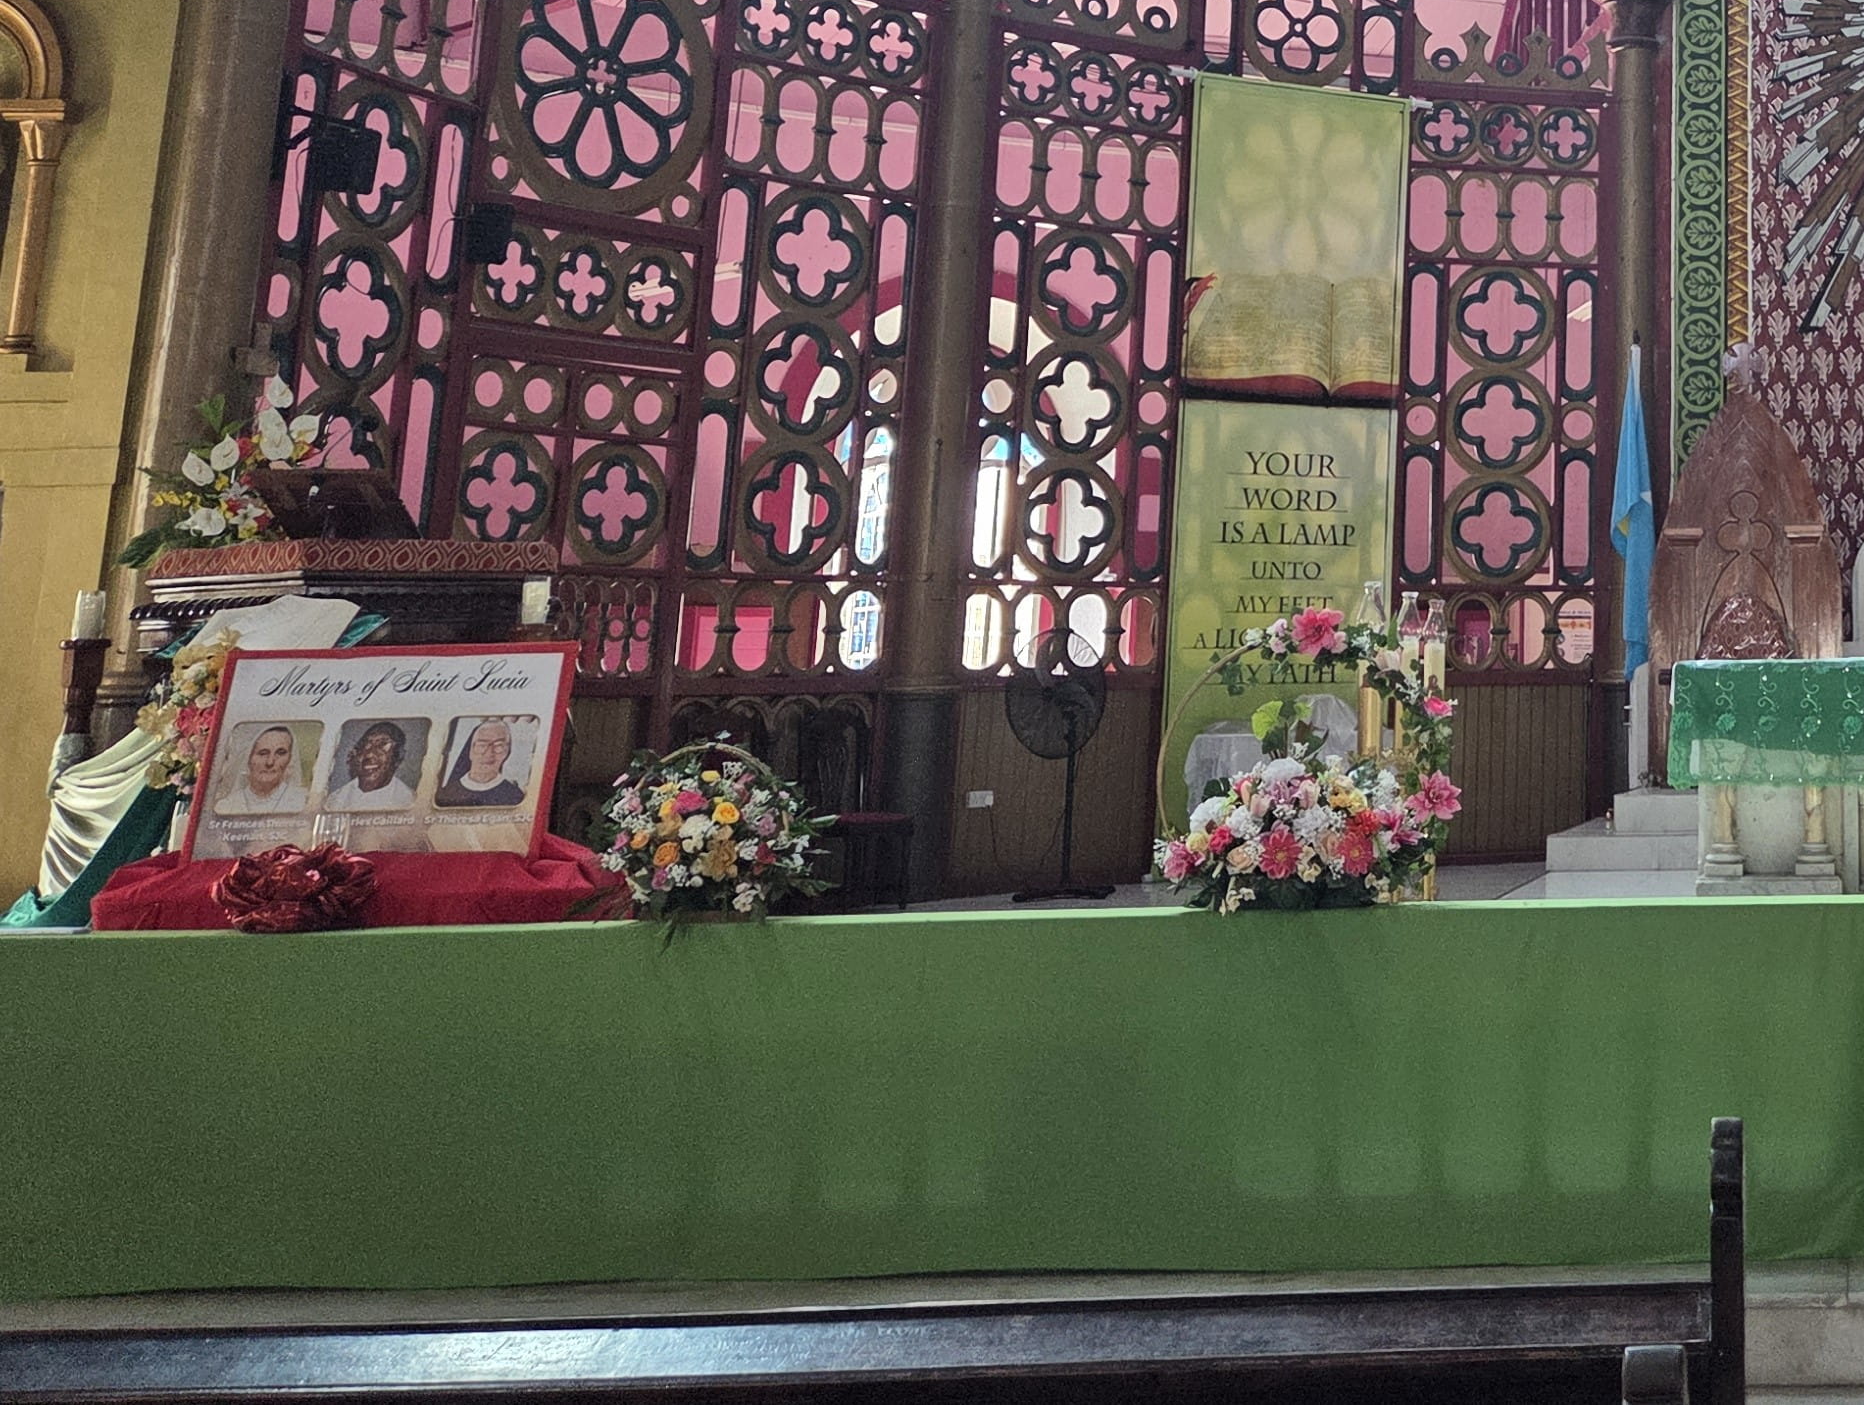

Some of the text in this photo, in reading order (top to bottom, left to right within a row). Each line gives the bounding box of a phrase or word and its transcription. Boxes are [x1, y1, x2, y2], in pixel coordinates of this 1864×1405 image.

[1246, 451, 1337, 478] YOUR
[1241, 487, 1337, 512] WORD
[1220, 521, 1355, 546] IS A LAMP
[1251, 561, 1322, 580] UNTO
[1235, 595, 1272, 613] MY
[1194, 632, 1207, 649] A
[260, 659, 531, 707] Martyrs of Saint Lucia
